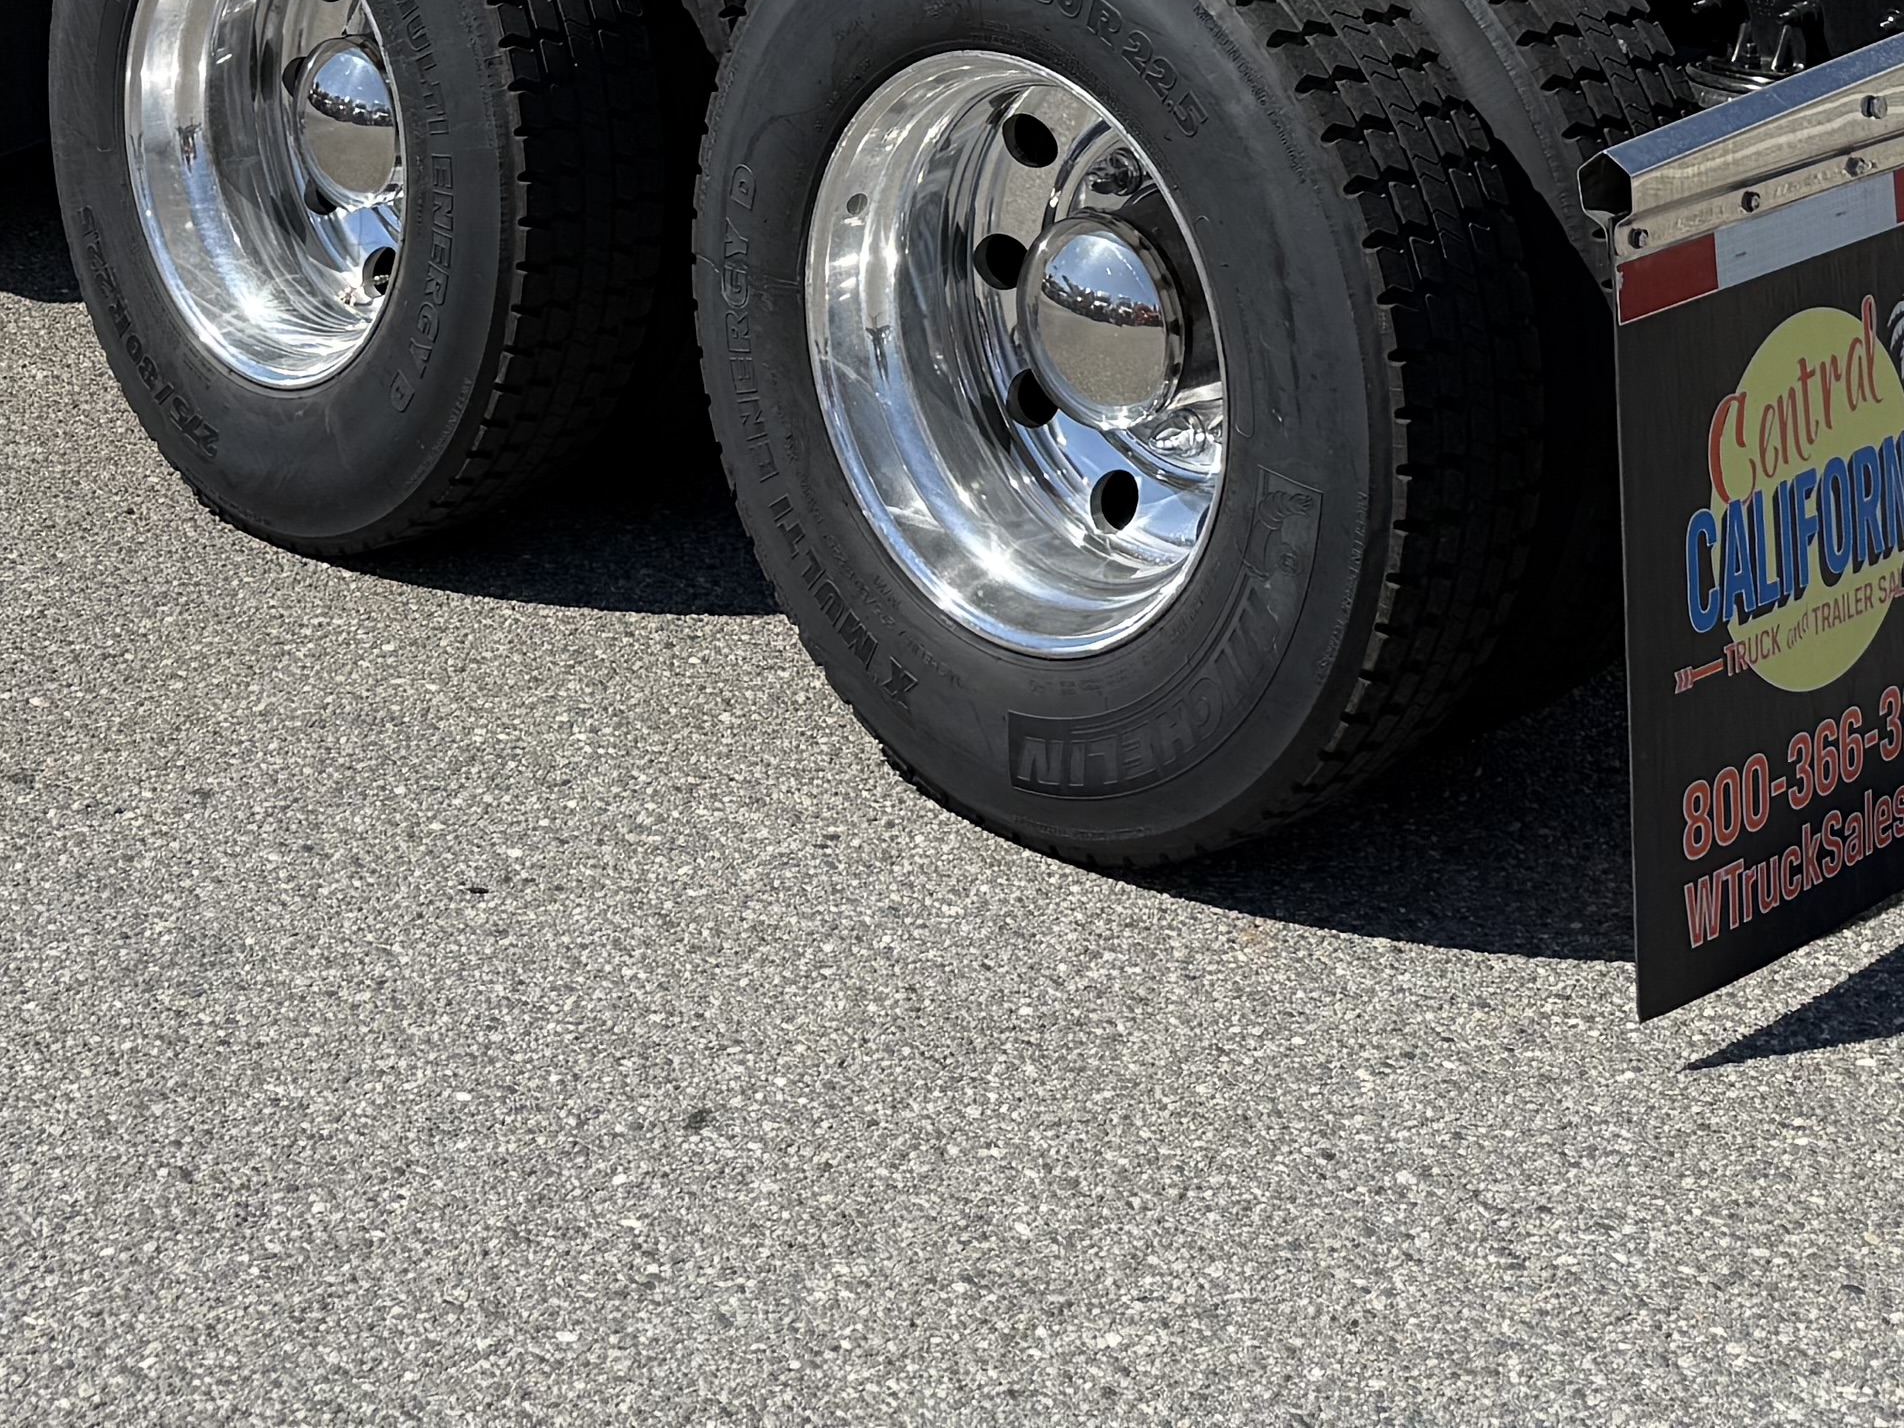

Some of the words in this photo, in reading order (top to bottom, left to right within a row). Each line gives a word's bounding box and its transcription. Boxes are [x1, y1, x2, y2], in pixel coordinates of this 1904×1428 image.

[1121, 28, 1210, 139] 22.5
[407, 153, 455, 380] ENERGY
[729, 162, 757, 211] D
[719, 216, 780, 485] ENERGY
[1708, 292, 1884, 510] Central
[768, 494, 882, 673] MULTI
[1724, 627, 1782, 677] TRUCK
[1785, 609, 1811, 656] and
[1811, 583, 1874, 641] TRAILER
[880, 655, 921, 709] X
[1016, 584, 1282, 788] MICHELIN
